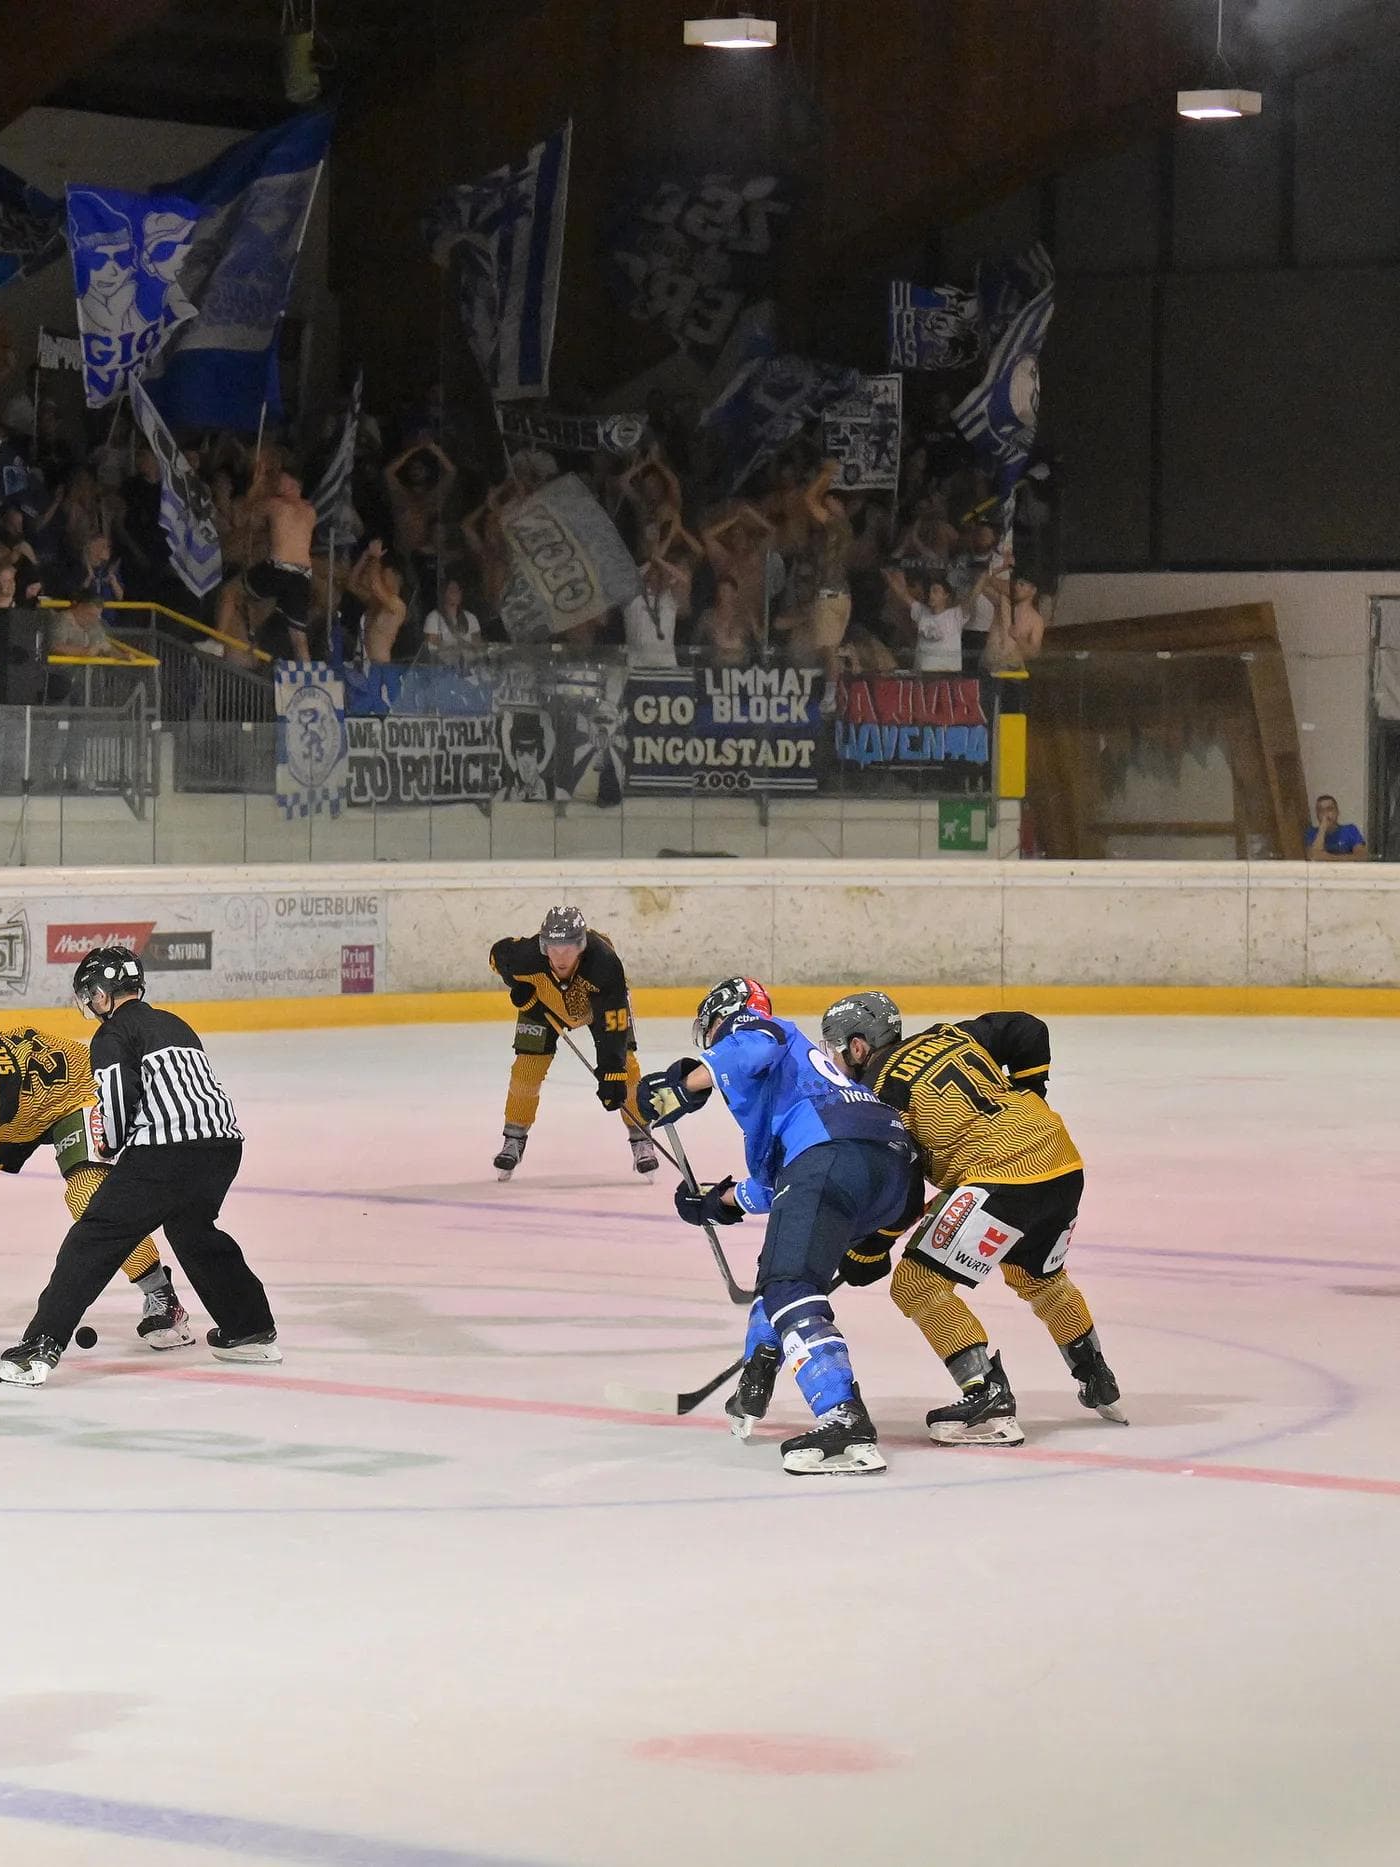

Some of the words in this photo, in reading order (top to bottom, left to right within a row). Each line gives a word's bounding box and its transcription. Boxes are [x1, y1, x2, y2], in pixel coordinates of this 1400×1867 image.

[704, 666, 823, 697] LIMMAT
[633, 695, 695, 725] GIO
[712, 695, 810, 724] BLOCK
[444, 719, 495, 747] TALK
[632, 735, 816, 768] INGOLSTADT
[347, 755, 389, 798] TO
[398, 752, 502, 797] POLICE
[694, 771, 752, 790] 2006
[275, 897, 297, 917] OP
[300, 896, 379, 917] WERBUNG
[168, 943, 206, 961] SATURN
[343, 949, 370, 964] Print
[604, 1008, 628, 1032] 59
[925, 1048, 1011, 1121] 71
[934, 1194, 973, 1247] GERAX
